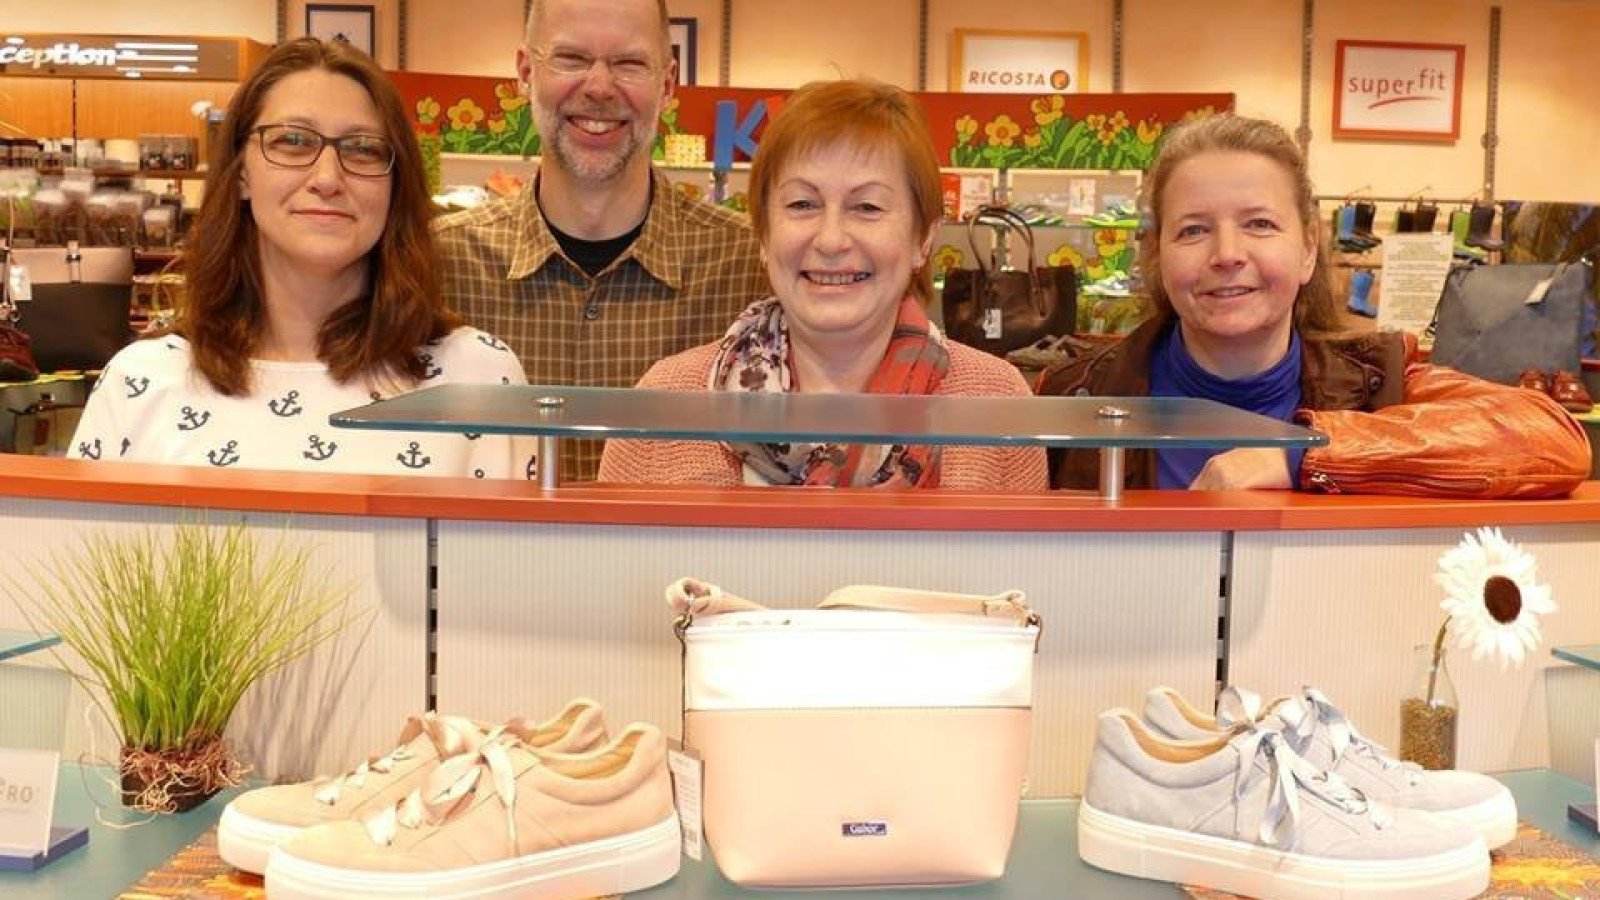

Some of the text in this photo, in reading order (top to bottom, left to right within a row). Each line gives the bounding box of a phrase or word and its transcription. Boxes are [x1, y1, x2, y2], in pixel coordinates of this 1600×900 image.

[968, 69, 1046, 86] RICOSTA
[1347, 67, 1446, 98] superfit
[714, 96, 782, 171] K
